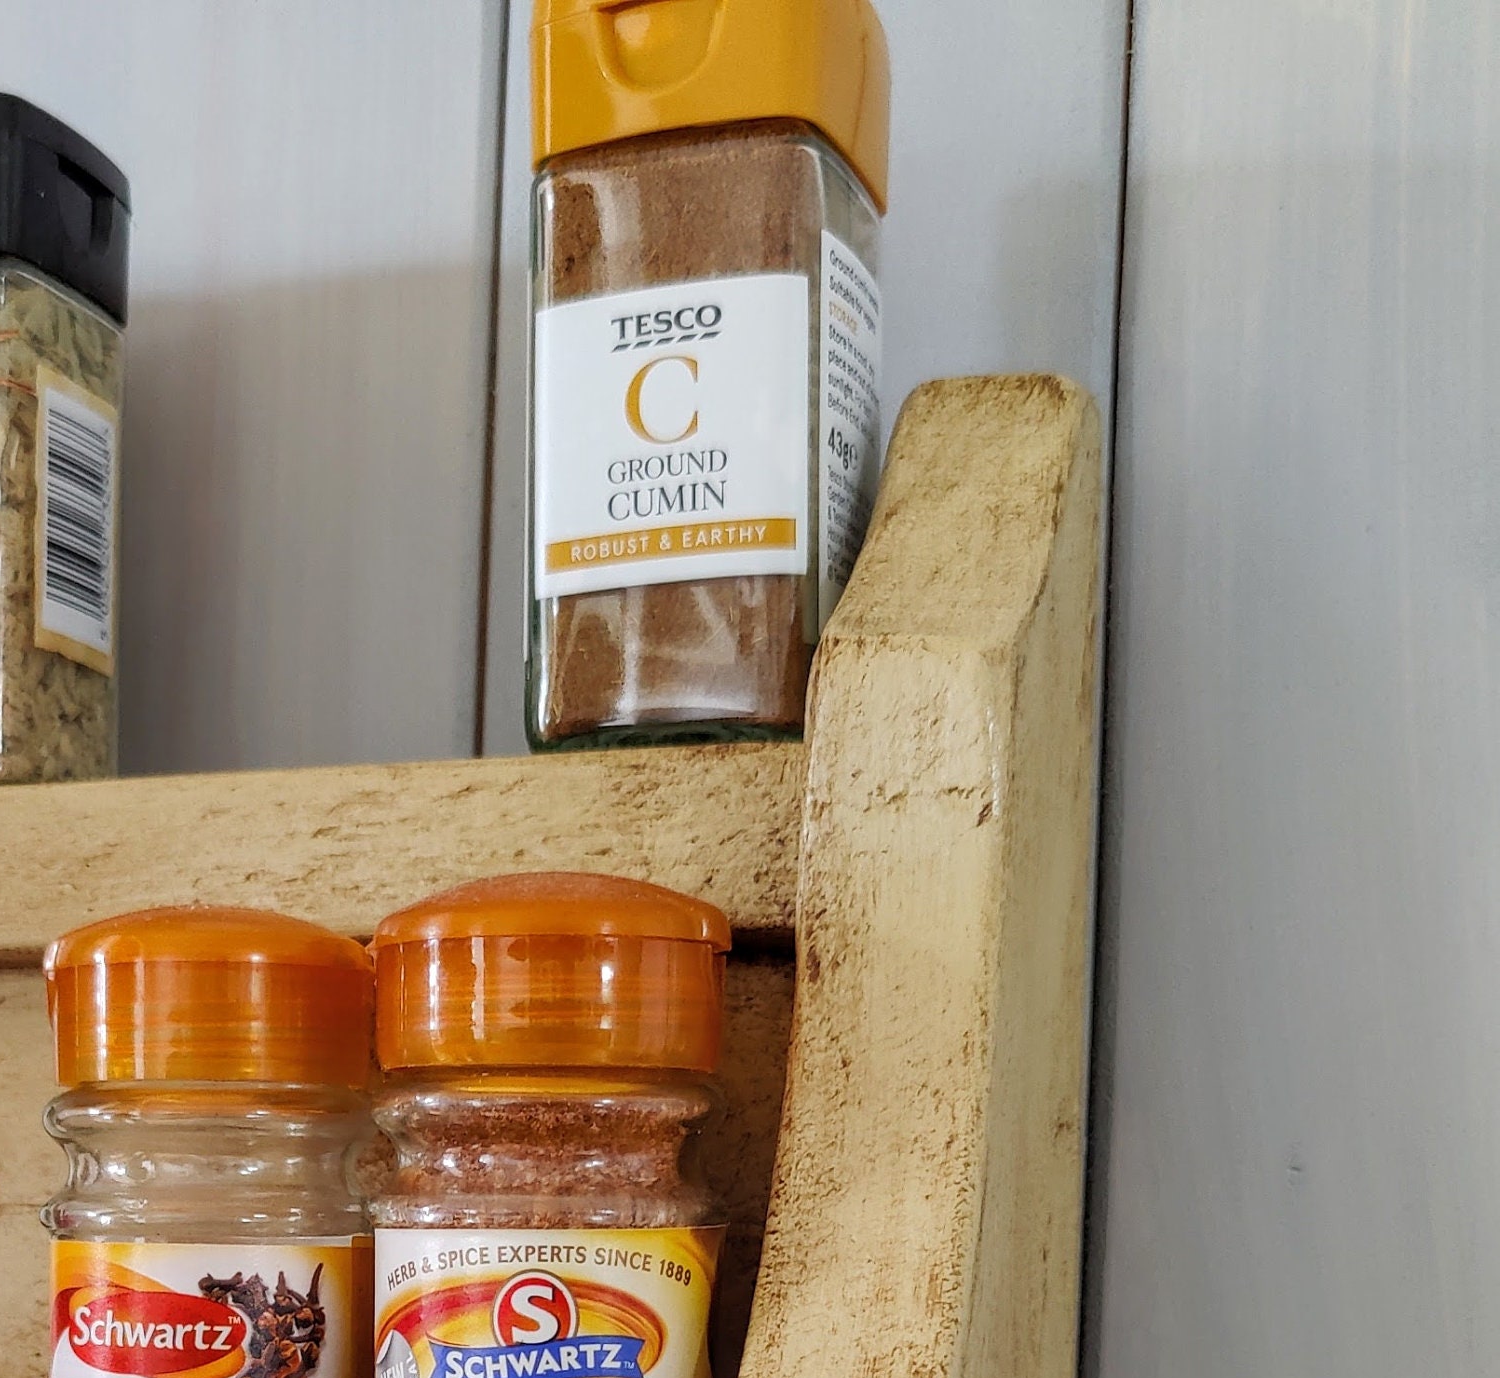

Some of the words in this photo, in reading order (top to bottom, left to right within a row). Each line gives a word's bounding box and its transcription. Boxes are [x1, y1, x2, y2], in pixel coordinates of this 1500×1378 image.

[611, 304, 722, 340] TESCO
[624, 355, 699, 444] C
[607, 449, 727, 485] GROUND
[607, 480, 727, 521] CUMIN
[570, 537, 650, 563] ROBUST
[659, 533, 673, 550] &
[682, 525, 767, 547] EARTHY
[387, 1261, 417, 1291] HERB
[421, 1257, 434, 1274] &
[438, 1246, 490, 1270] SPICE
[498, 1245, 587, 1264] EXPERTS
[594, 1247, 652, 1272] SINCE
[659, 1259, 692, 1286] 1889
[72, 1307, 234, 1351] Schwartz
[510, 1285, 559, 1344] S
